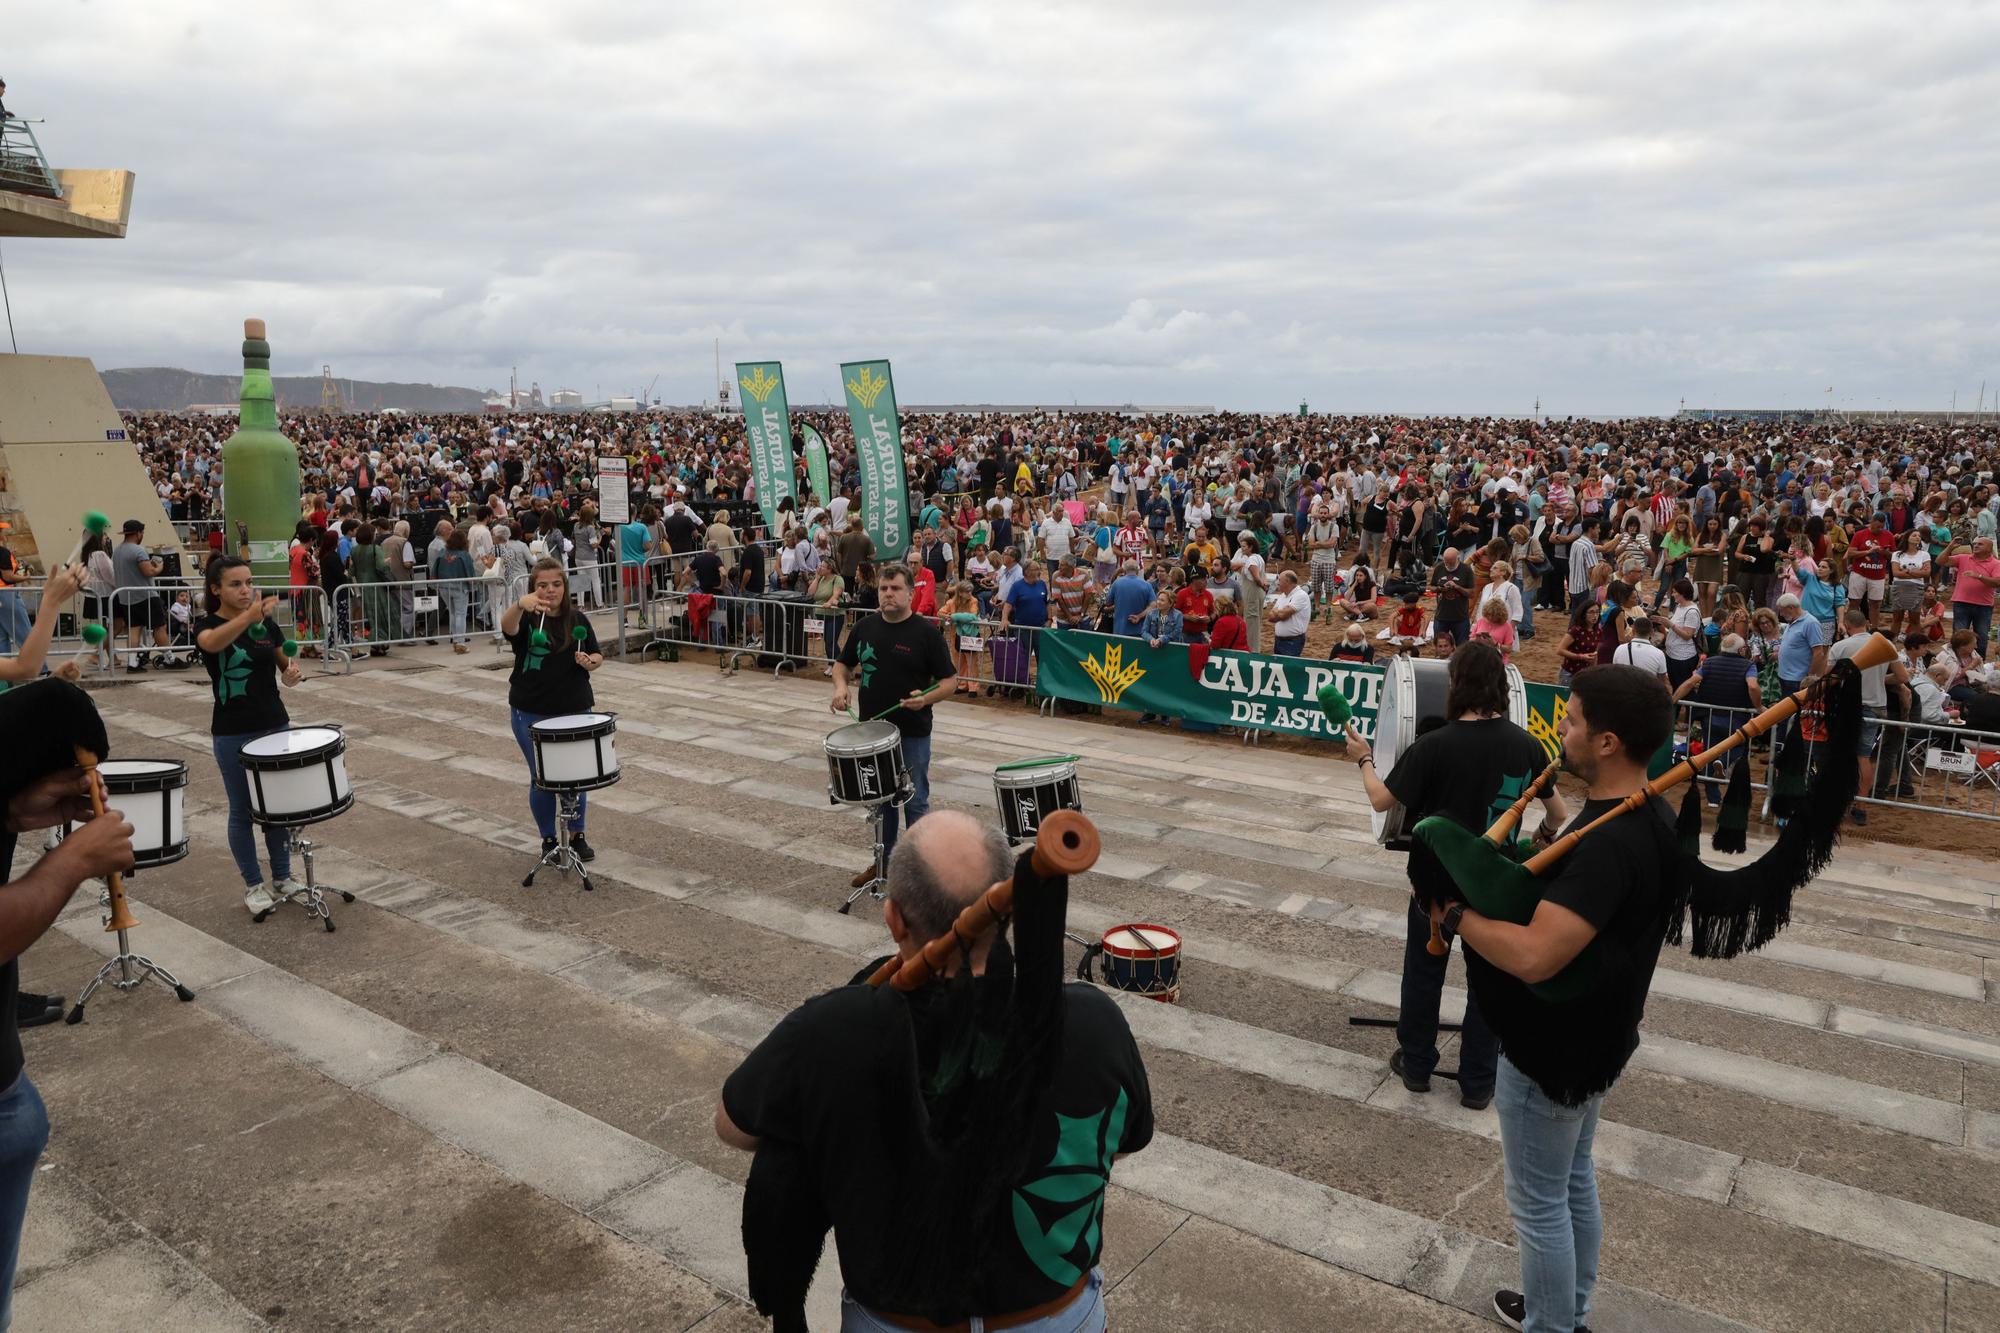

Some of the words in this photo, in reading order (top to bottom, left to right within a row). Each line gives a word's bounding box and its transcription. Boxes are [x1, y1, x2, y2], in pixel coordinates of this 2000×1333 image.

[1199, 655, 1294, 699] CAJA
[1230, 700, 1267, 724] DE
[1271, 706, 1377, 740] ASTURI
[859, 761, 877, 795] Pearl
[1017, 793, 1038, 832] Pearl
